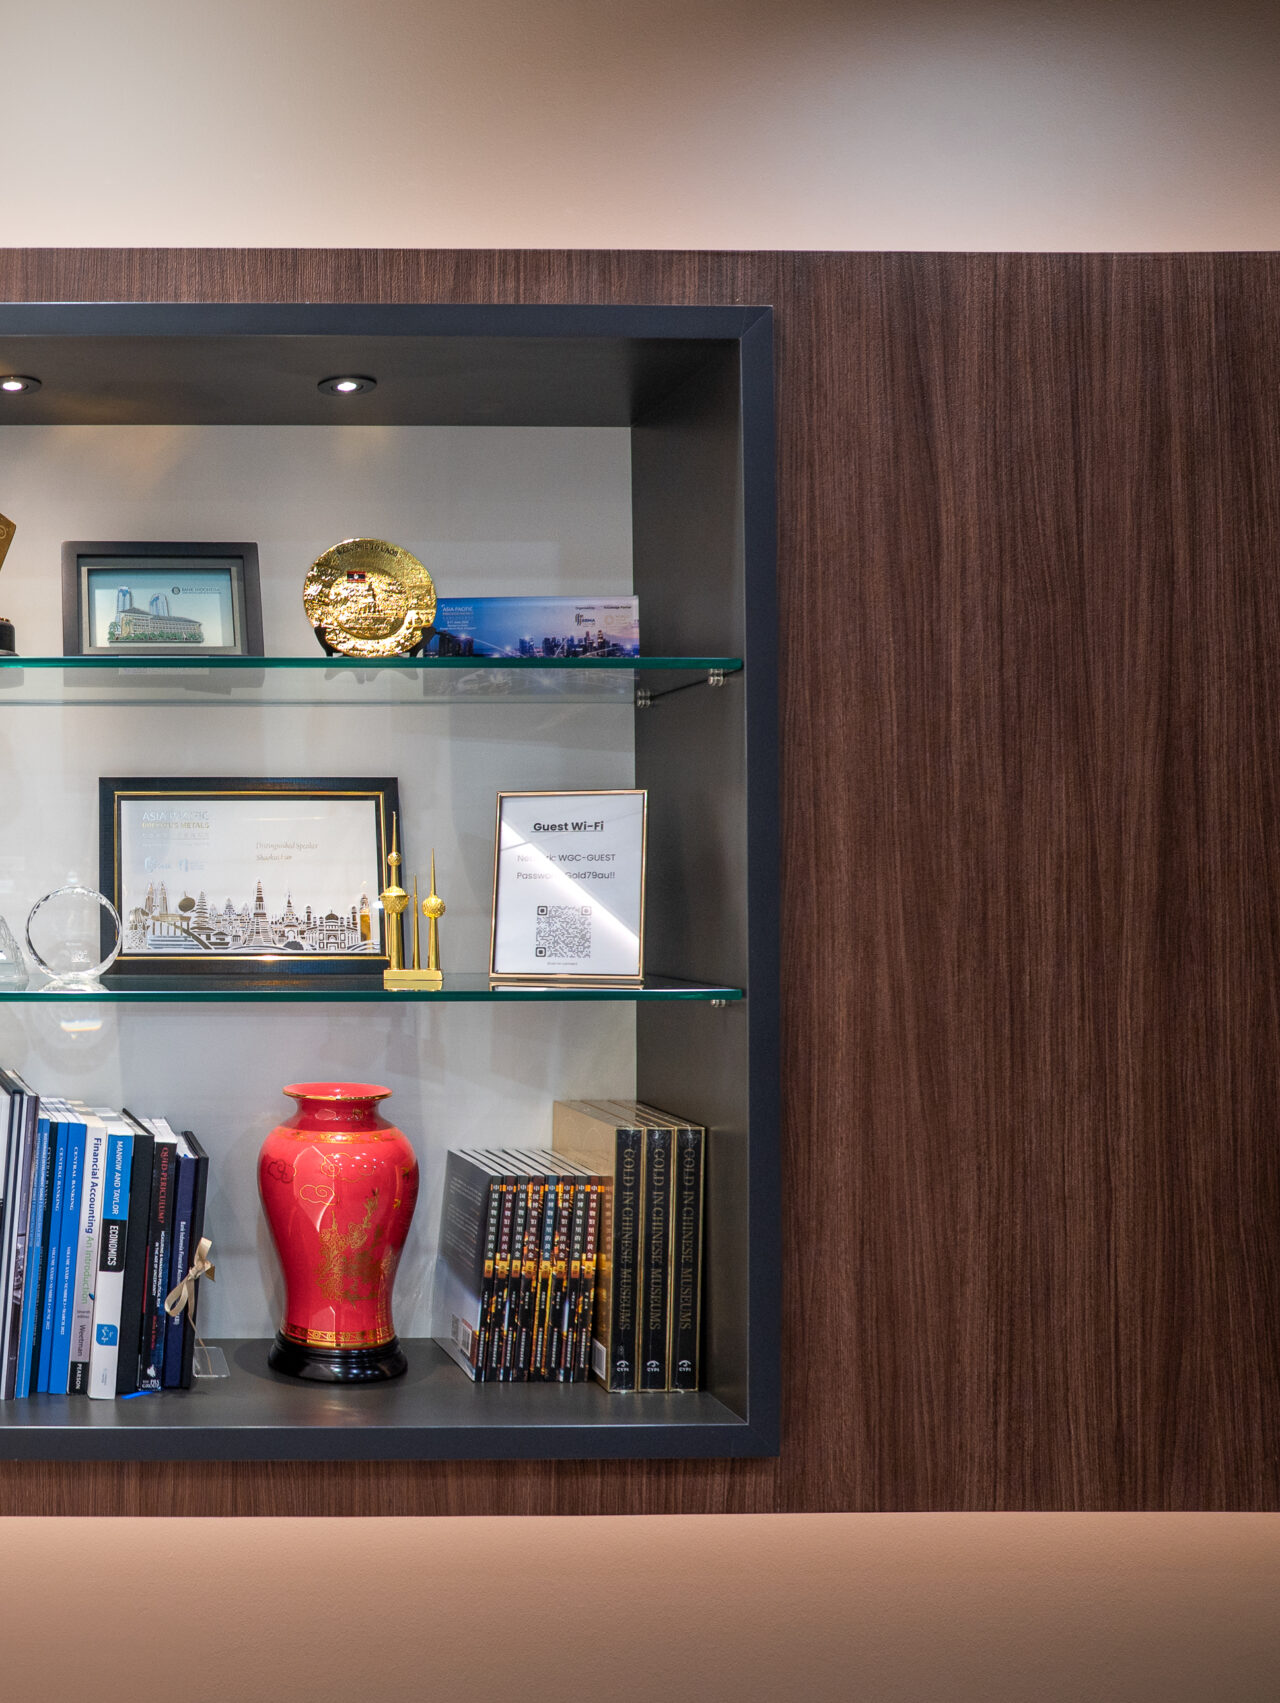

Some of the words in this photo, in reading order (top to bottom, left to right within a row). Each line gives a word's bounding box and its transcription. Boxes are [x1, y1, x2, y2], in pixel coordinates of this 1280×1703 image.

[533, 822, 568, 831] Guest
[571, 821, 604, 831] Wi-Fi
[558, 853, 616, 862] WGC-GUEST
[91, 1137, 102, 1179] Financial
[115, 1140, 123, 1171] MANKIW
[160, 1146, 169, 1171] QUID
[623, 1148, 635, 1186] GOLD
[653, 1148, 665, 1186] GOLD
[683, 1148, 695, 1186] GOLD
[113, 1171, 122, 1188] AND
[158, 1172, 168, 1224] PERICULUM?
[623, 1191, 634, 1205] IN
[653, 1191, 664, 1205] IN
[683, 1191, 694, 1205] IN
[85, 1181, 98, 1234] Accounting
[111, 1188, 121, 1215] TAYLOR
[85, 1235, 95, 1249] An
[107, 1225, 119, 1266] ECONOMICS
[621, 1207, 633, 1263] CHINESE
[651, 1207, 663, 1263] CHINESE
[681, 1207, 693, 1263] CHINESE
[81, 1249, 93, 1304] Introduction
[177, 1251, 185, 1270] Financial
[619, 1268, 632, 1330] MUSEUMS
[649, 1268, 662, 1330] MUSEUMS
[679, 1268, 692, 1330] MUSEUMS
[77, 1324, 86, 1357] Weetman
